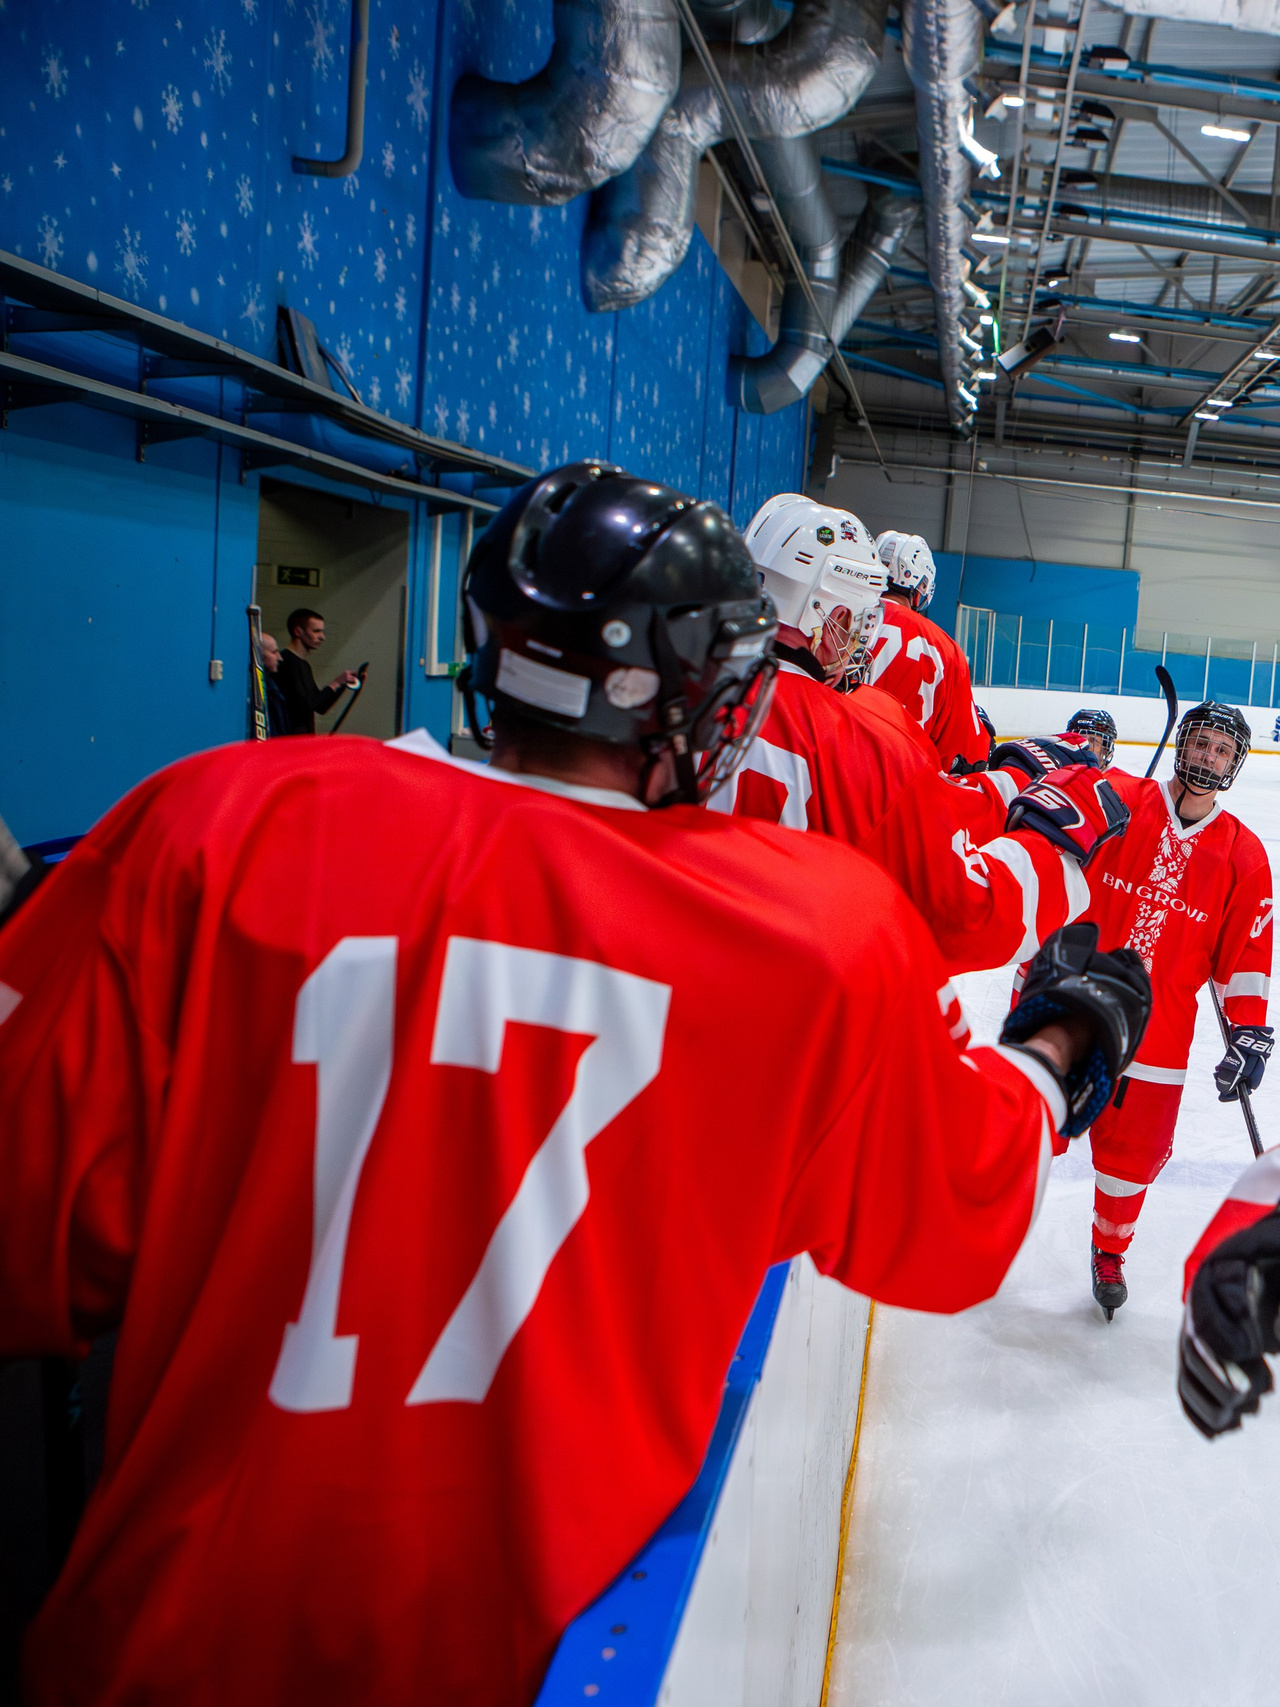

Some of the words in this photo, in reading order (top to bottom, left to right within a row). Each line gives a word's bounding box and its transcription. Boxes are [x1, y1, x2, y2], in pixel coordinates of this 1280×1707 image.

[833, 564, 870, 581] BAUER
[1102, 872, 1133, 894] BN
[1136, 885, 1209, 923] GROUP
[268, 935, 673, 1414] 17
